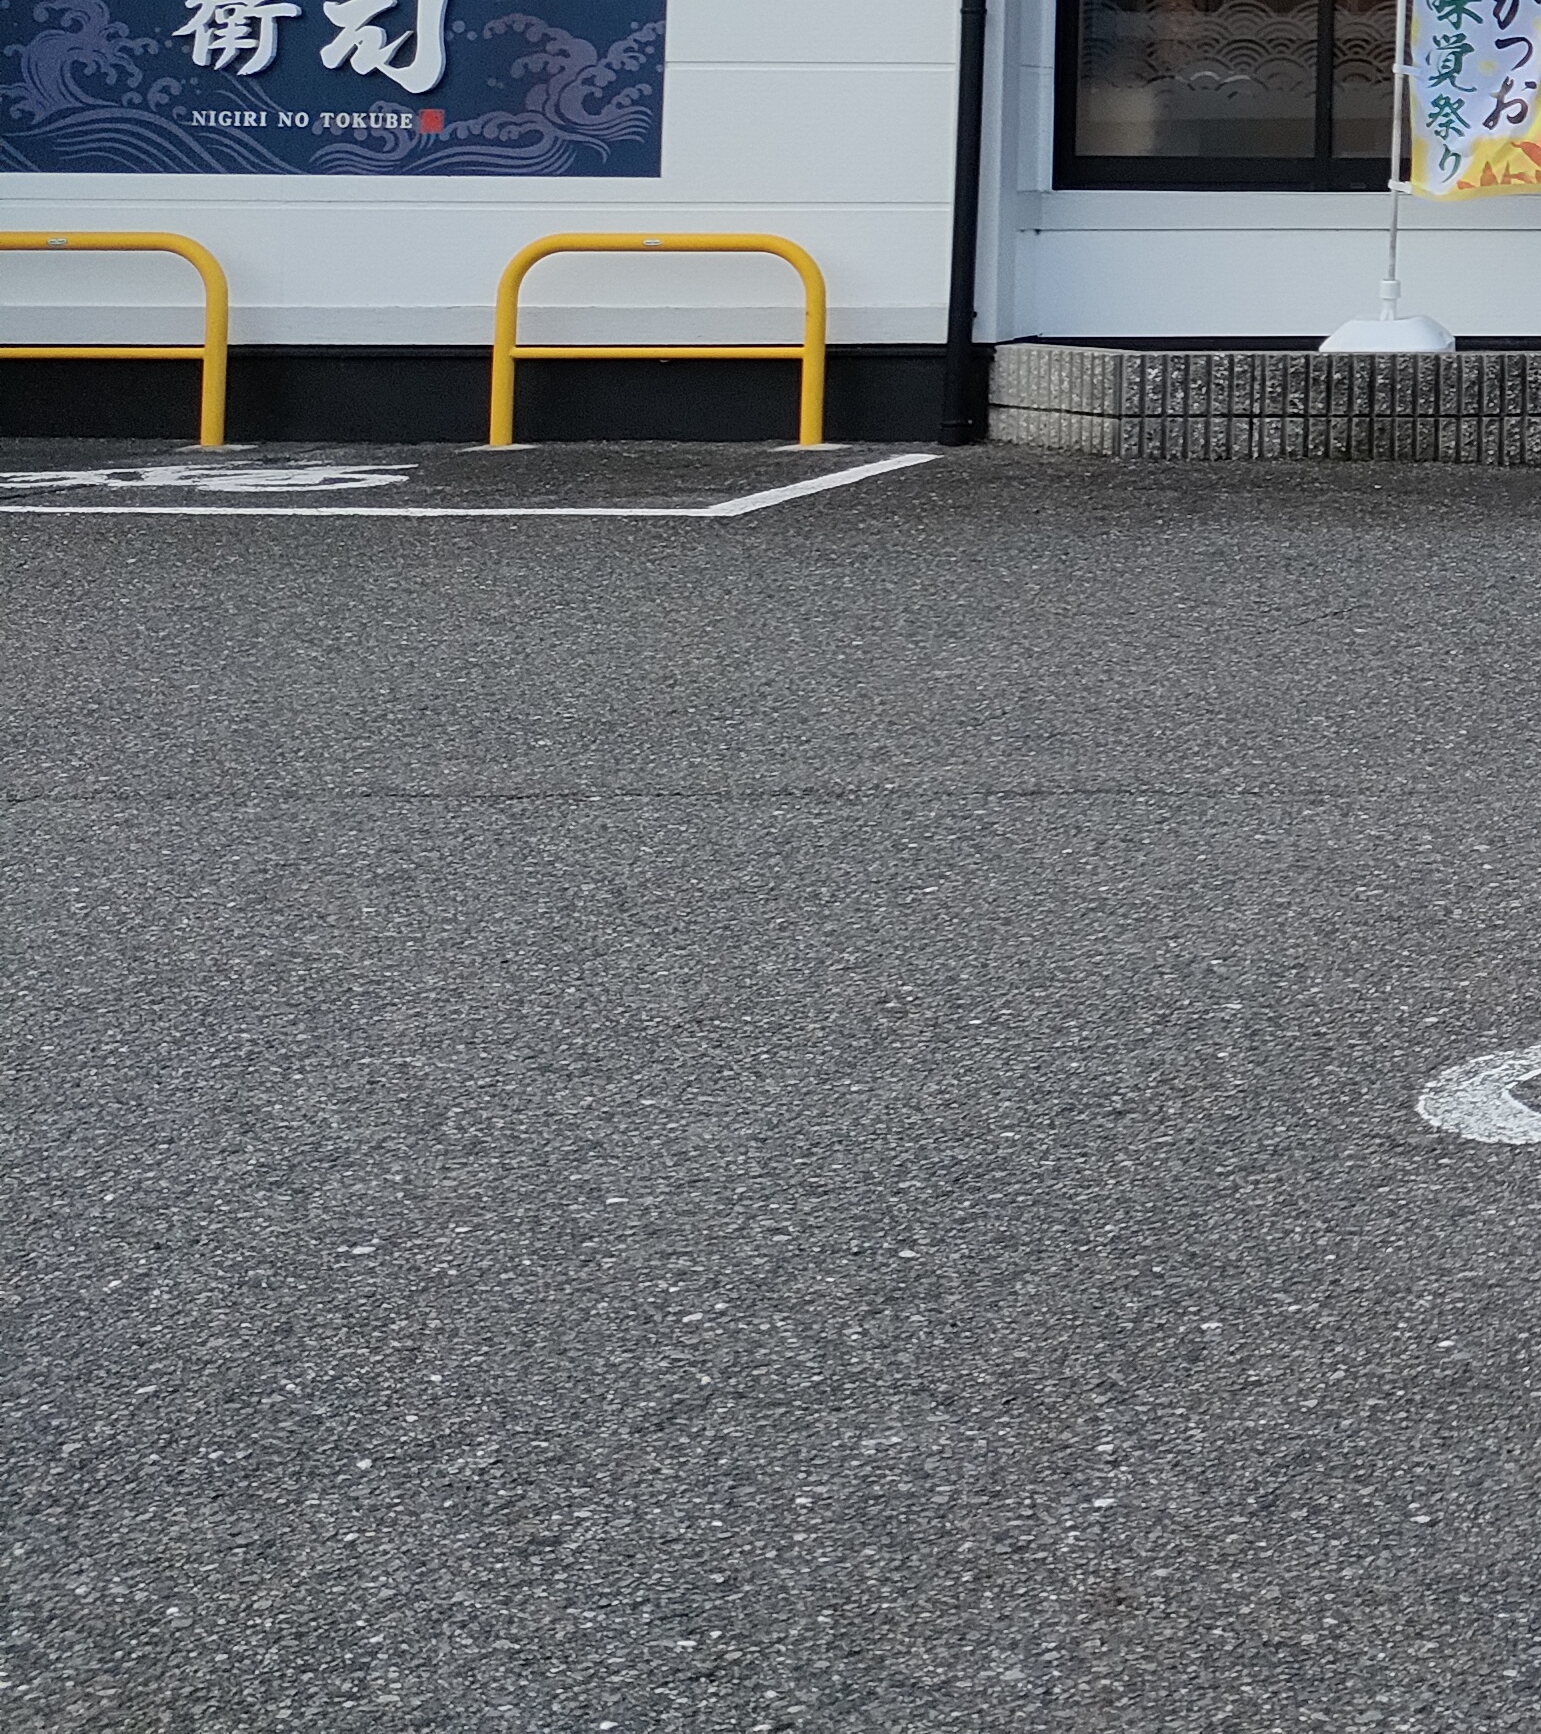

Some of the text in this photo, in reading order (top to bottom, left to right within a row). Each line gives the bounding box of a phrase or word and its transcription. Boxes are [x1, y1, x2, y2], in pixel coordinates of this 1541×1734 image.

[191, 110, 268, 127] NIGIRI
[278, 112, 309, 128] NO
[319, 113, 414, 129] TOKUBE
